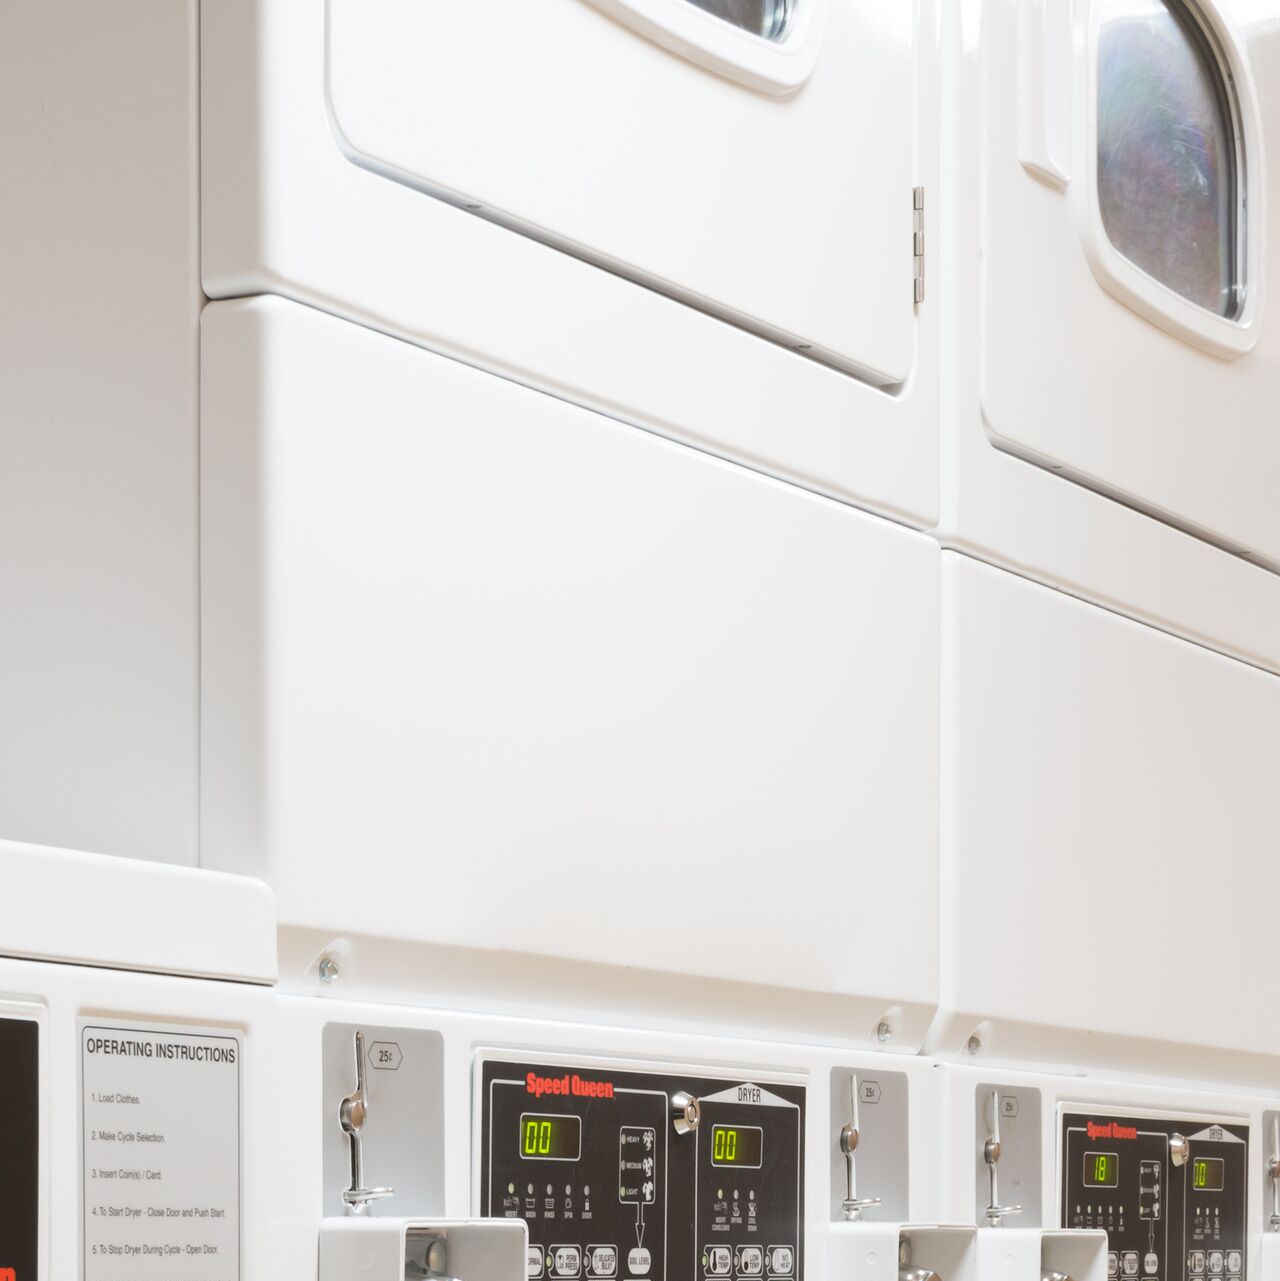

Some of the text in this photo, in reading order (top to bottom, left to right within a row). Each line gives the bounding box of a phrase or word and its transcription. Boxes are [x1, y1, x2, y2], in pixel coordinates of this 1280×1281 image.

[86, 1037, 236, 1063] OPERATING INSTRUCTIONS
[526, 1072, 614, 1099] Speed Queen
[98, 1092, 114, 1103] Load
[115, 1093, 141, 1104] Clothes.
[738, 1086, 762, 1103] DRYER
[99, 1131, 116, 1141] Make
[117, 1131, 135, 1144] Cycle
[136, 1132, 166, 1143] Selection.
[1087, 1120, 1137, 1141] Speed Queen
[714, 1130, 737, 1161] 00
[99, 1169, 117, 1179] Insert
[118, 1169, 141, 1181] Coin(s)
[1095, 1156, 1107, 1181] 18
[99, 1206, 107, 1217] To
[108, 1207, 124, 1217] Start
[125, 1207, 142, 1221] Dryer
[147, 1207, 164, 1218] Close
[166, 1207, 180, 1218] Door
[182, 1208, 193, 1218] and
[194, 1208, 209, 1218] Push
[210, 1208, 226, 1218] Start.
[99, 1244, 107, 1254] To
[108, 1244, 122, 1256] Stop
[124, 1244, 142, 1256] Dryer
[142, 1244, 163, 1256] During
[164, 1244, 181, 1256] Cycle
[186, 1244, 203, 1256] Open
[203, 1244, 218, 1254] Door.
[565, 1262, 578, 1271] PRESS
